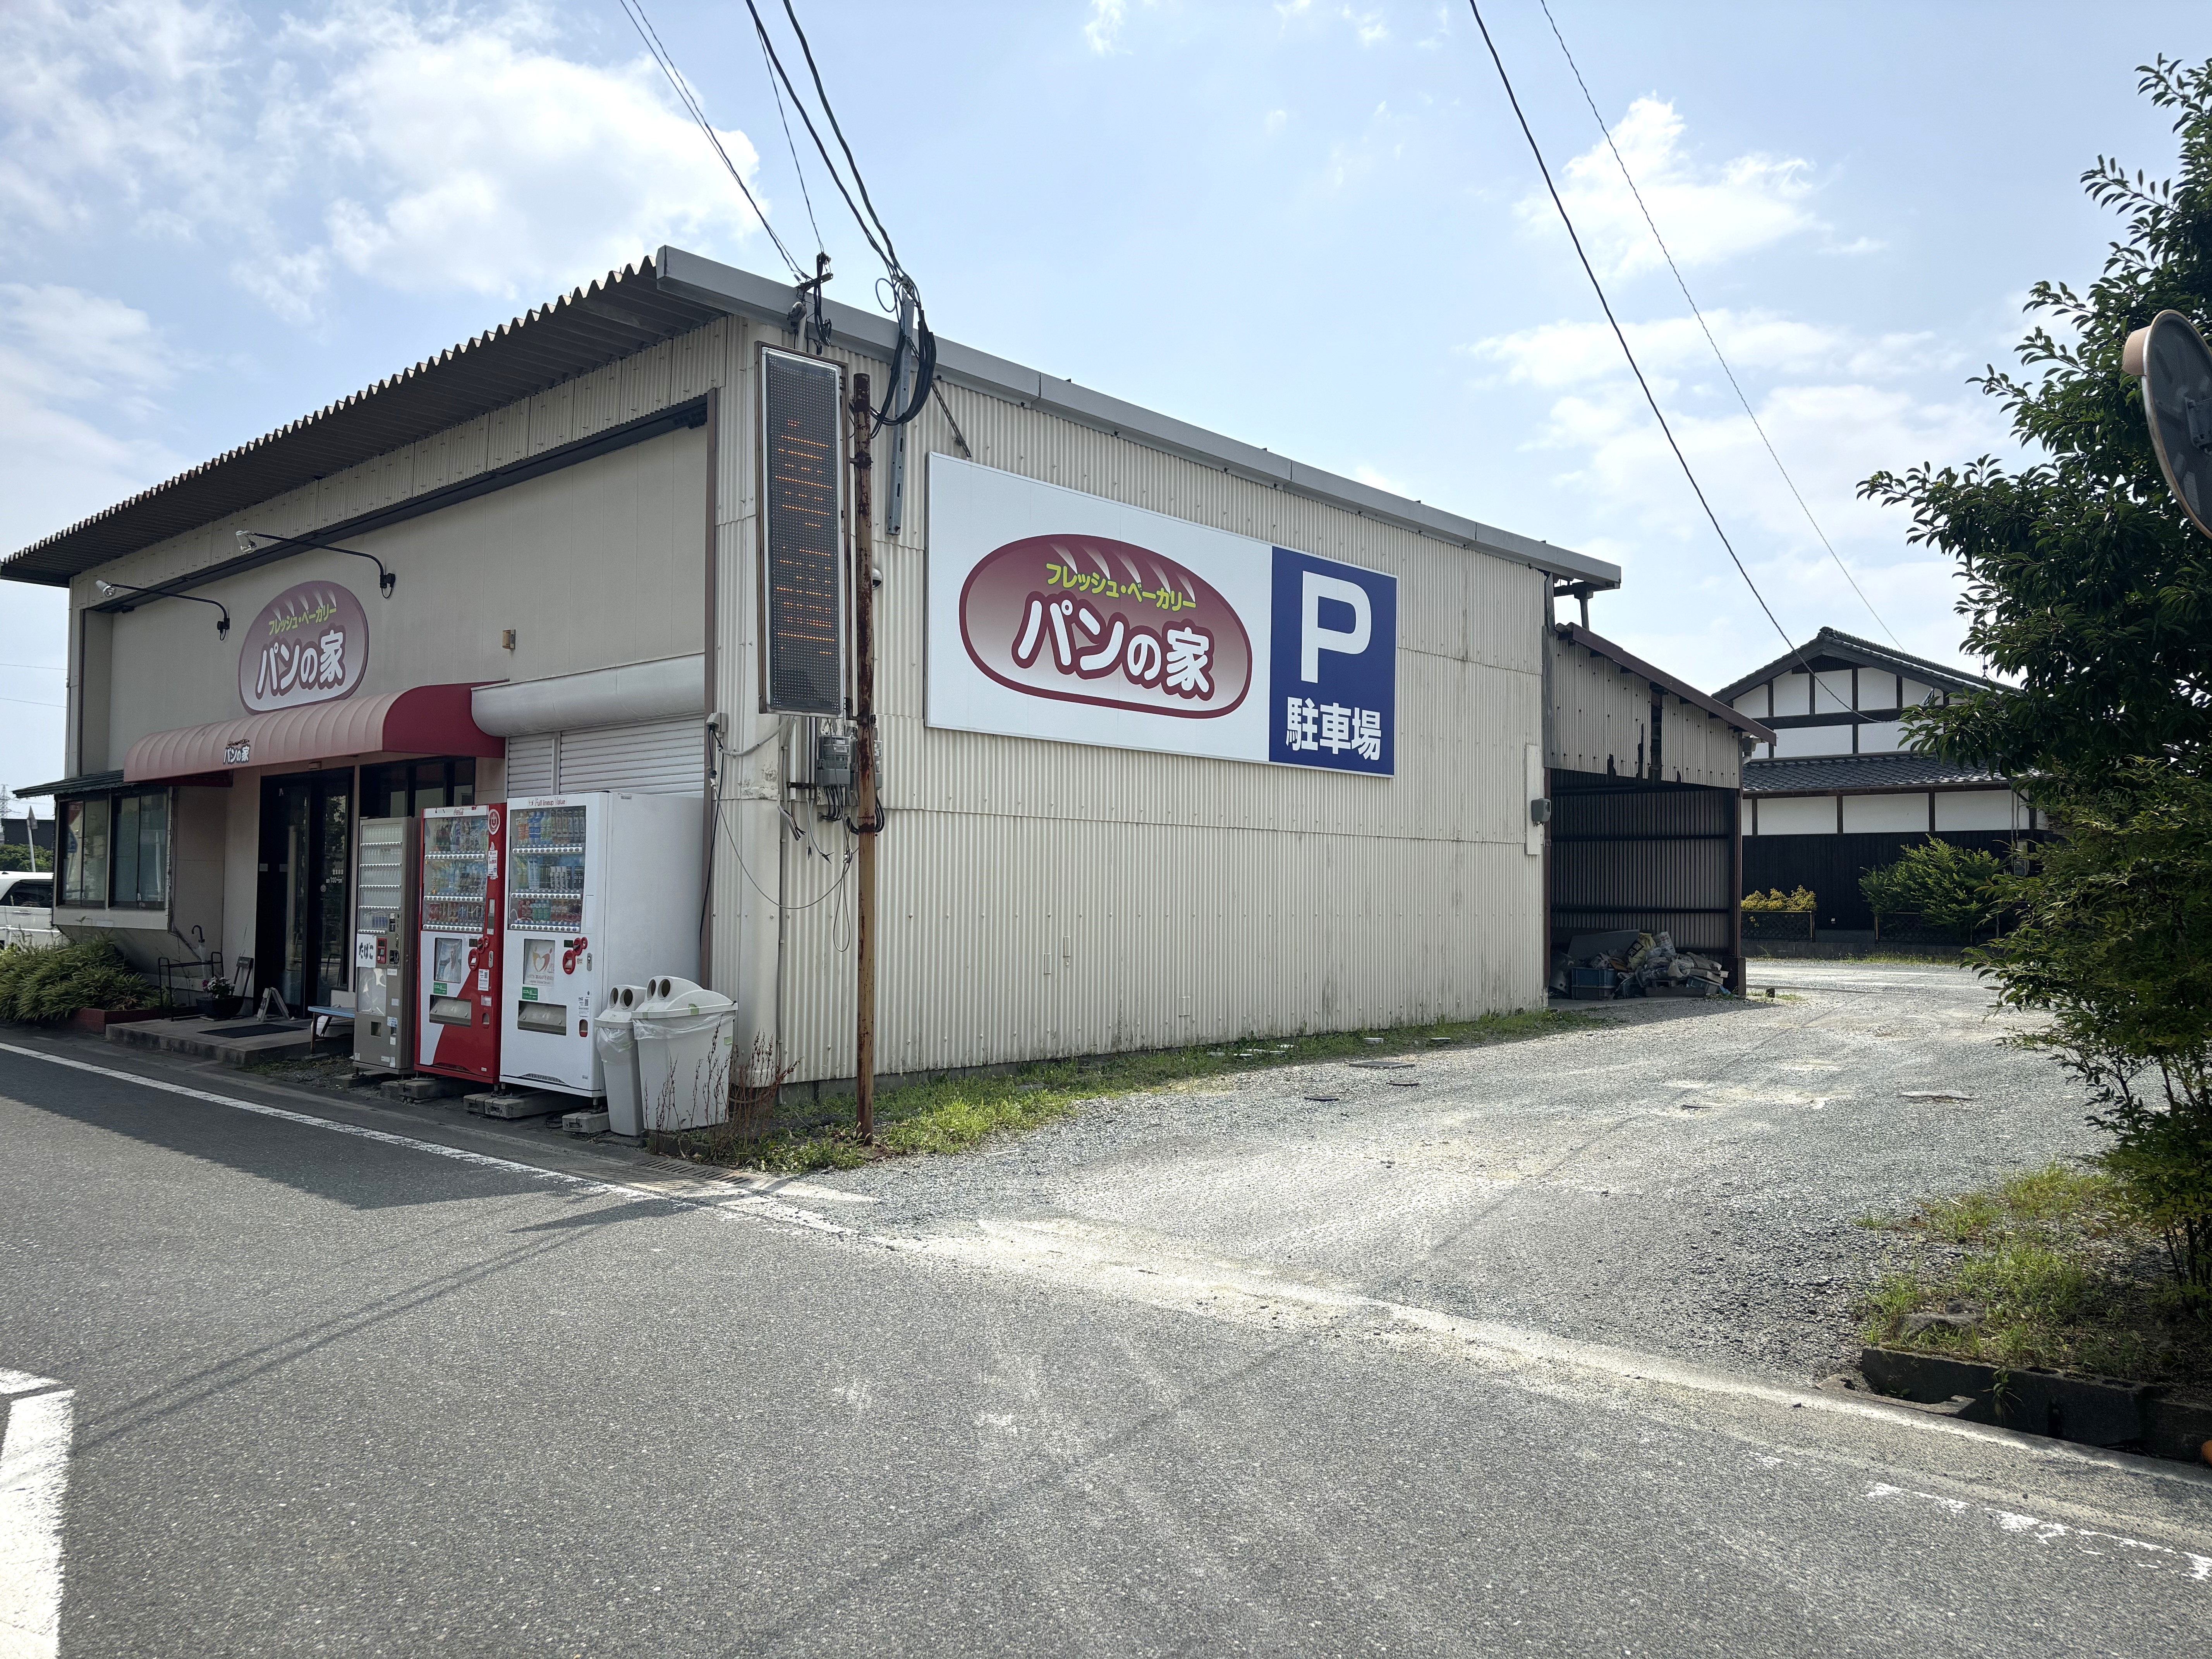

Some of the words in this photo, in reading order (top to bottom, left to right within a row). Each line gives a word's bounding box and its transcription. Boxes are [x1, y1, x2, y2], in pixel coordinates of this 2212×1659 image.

[1046, 563, 1197, 611] フレッシュ・ベーカリー
[269, 603, 337, 635] フレッシュ・ベーカリー
[1018, 599, 1210, 693] パンの家
[1301, 570, 1372, 684] P
[258, 629, 343, 694] パンの家
[223, 745, 250, 763] パンの家
[1286, 697, 1381, 761] 駐車場
[359, 942, 374, 960] たばこ
